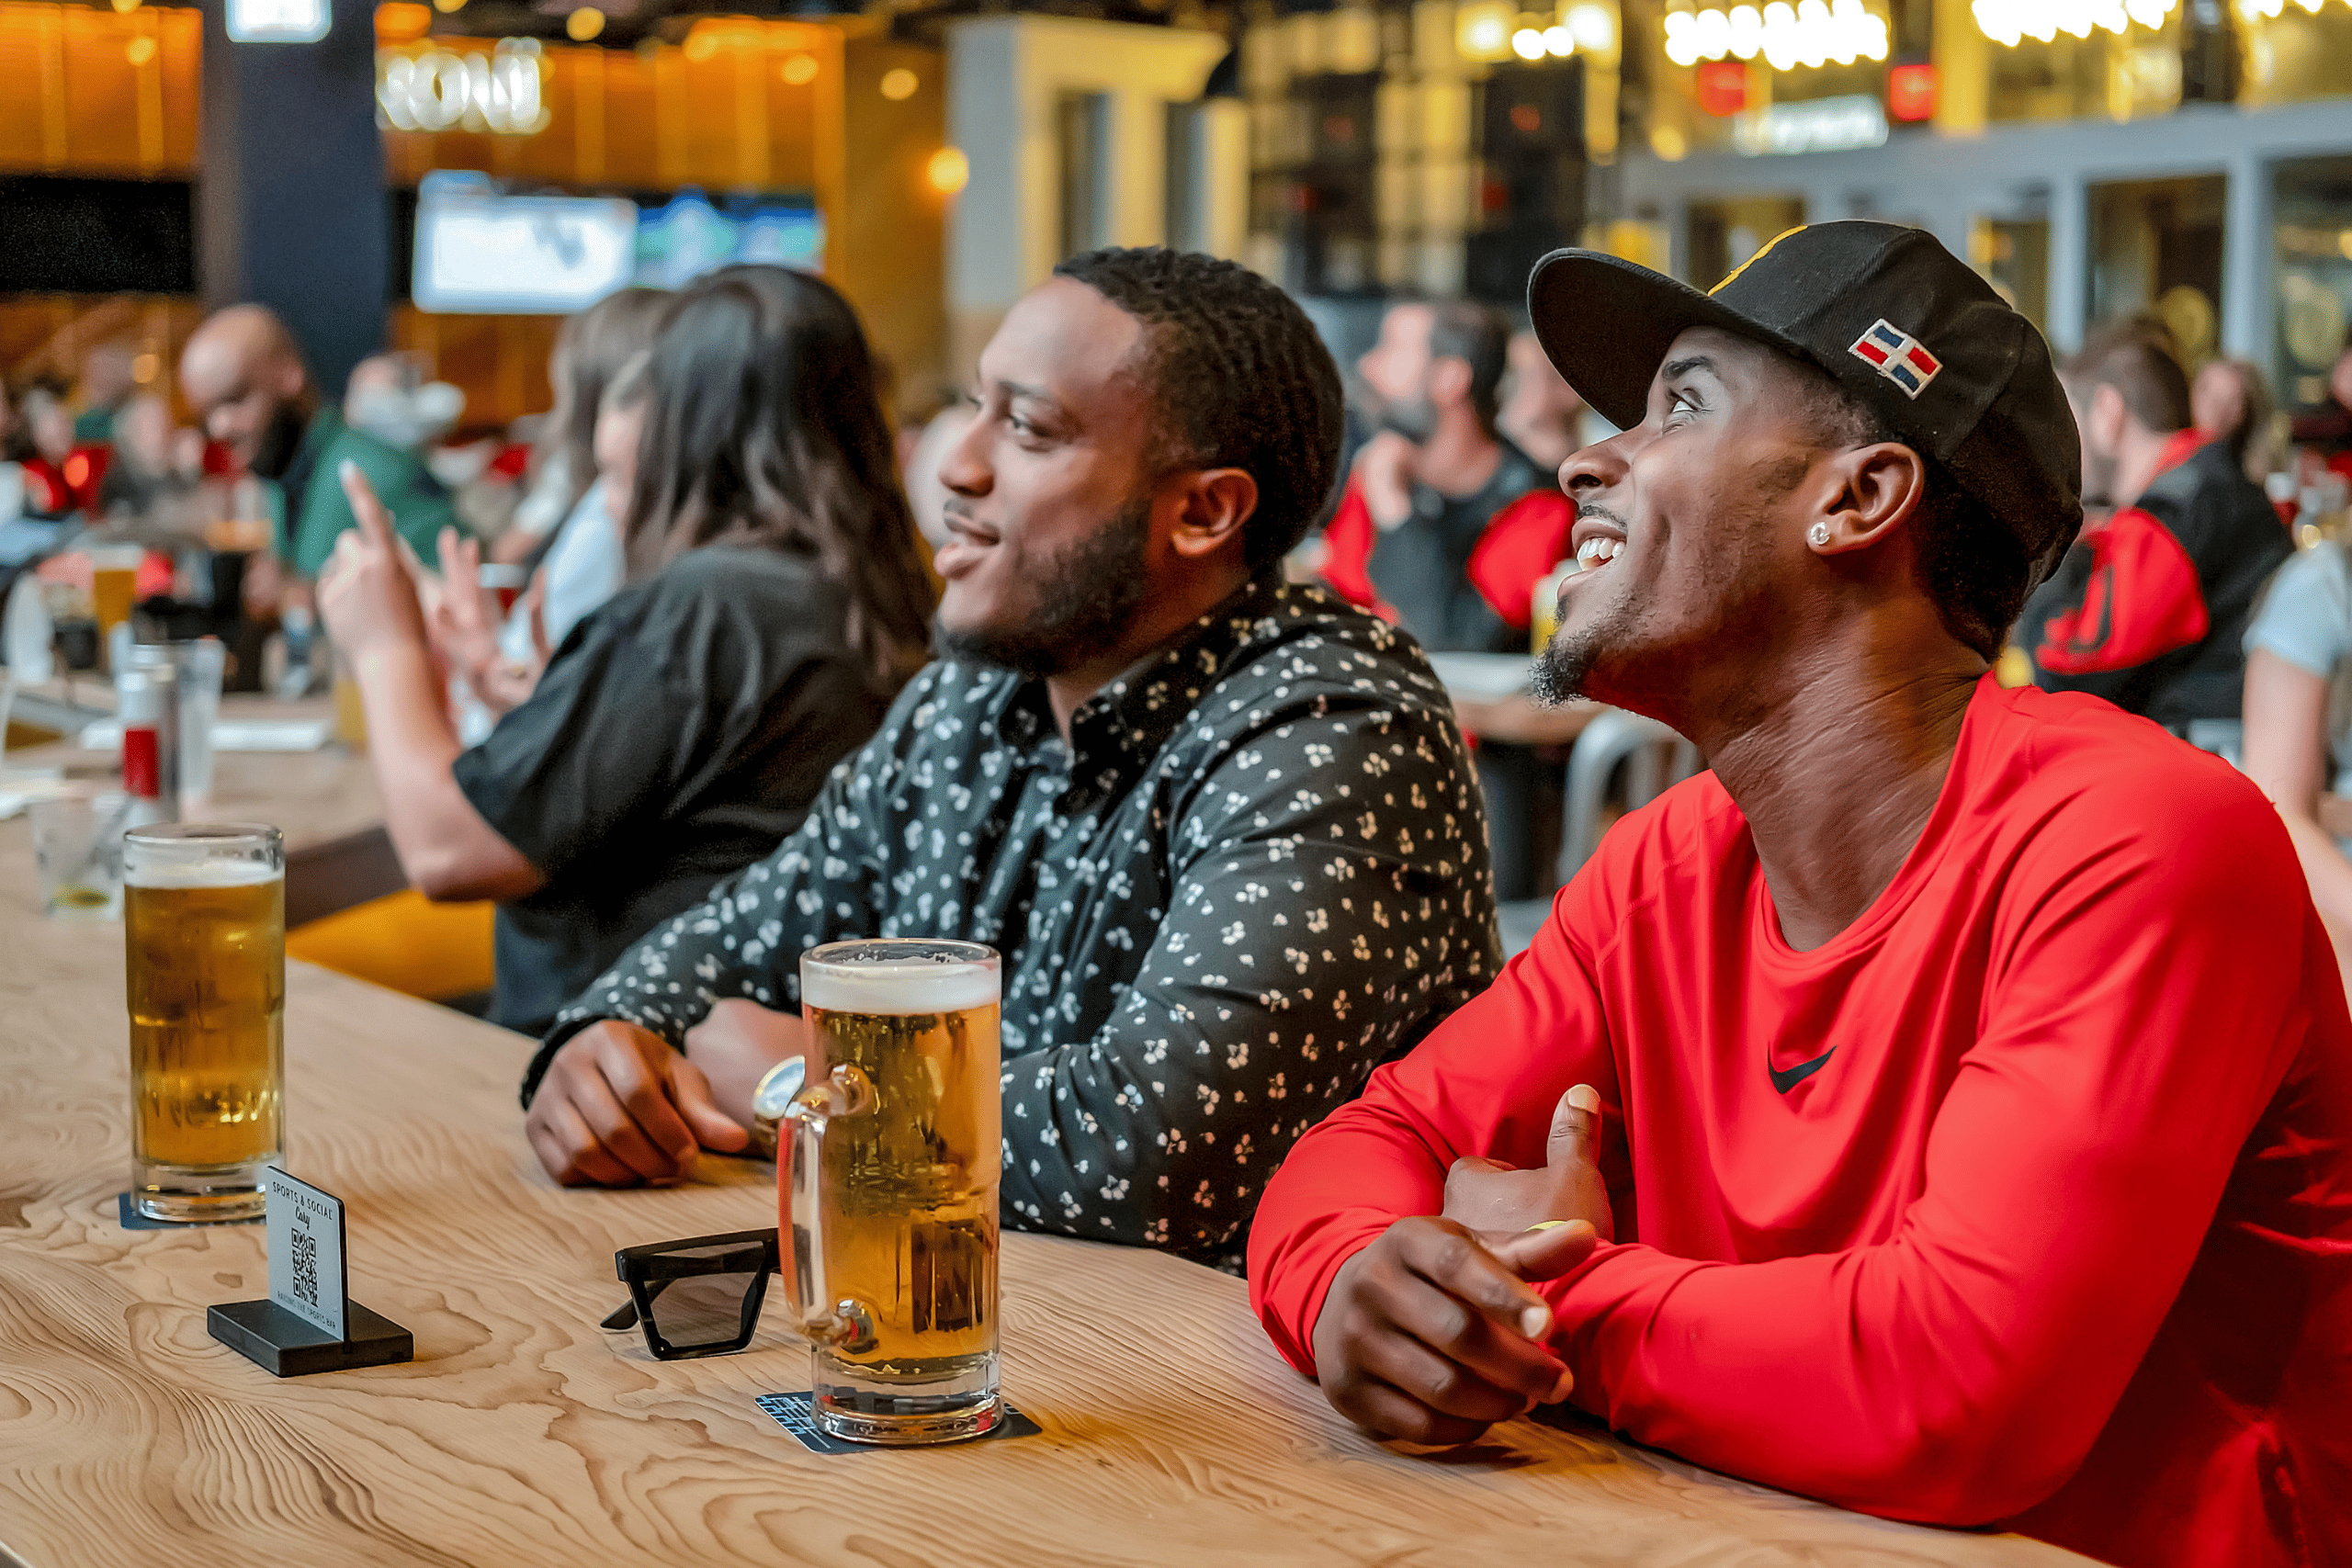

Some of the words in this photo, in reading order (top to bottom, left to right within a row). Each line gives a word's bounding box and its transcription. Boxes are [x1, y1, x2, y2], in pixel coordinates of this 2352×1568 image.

[273, 1181, 299, 1203] SPORTS
[300, 1195, 305, 1207] &
[307, 1198, 334, 1221] SOCIAL
[295, 1205, 311, 1231] Cary
